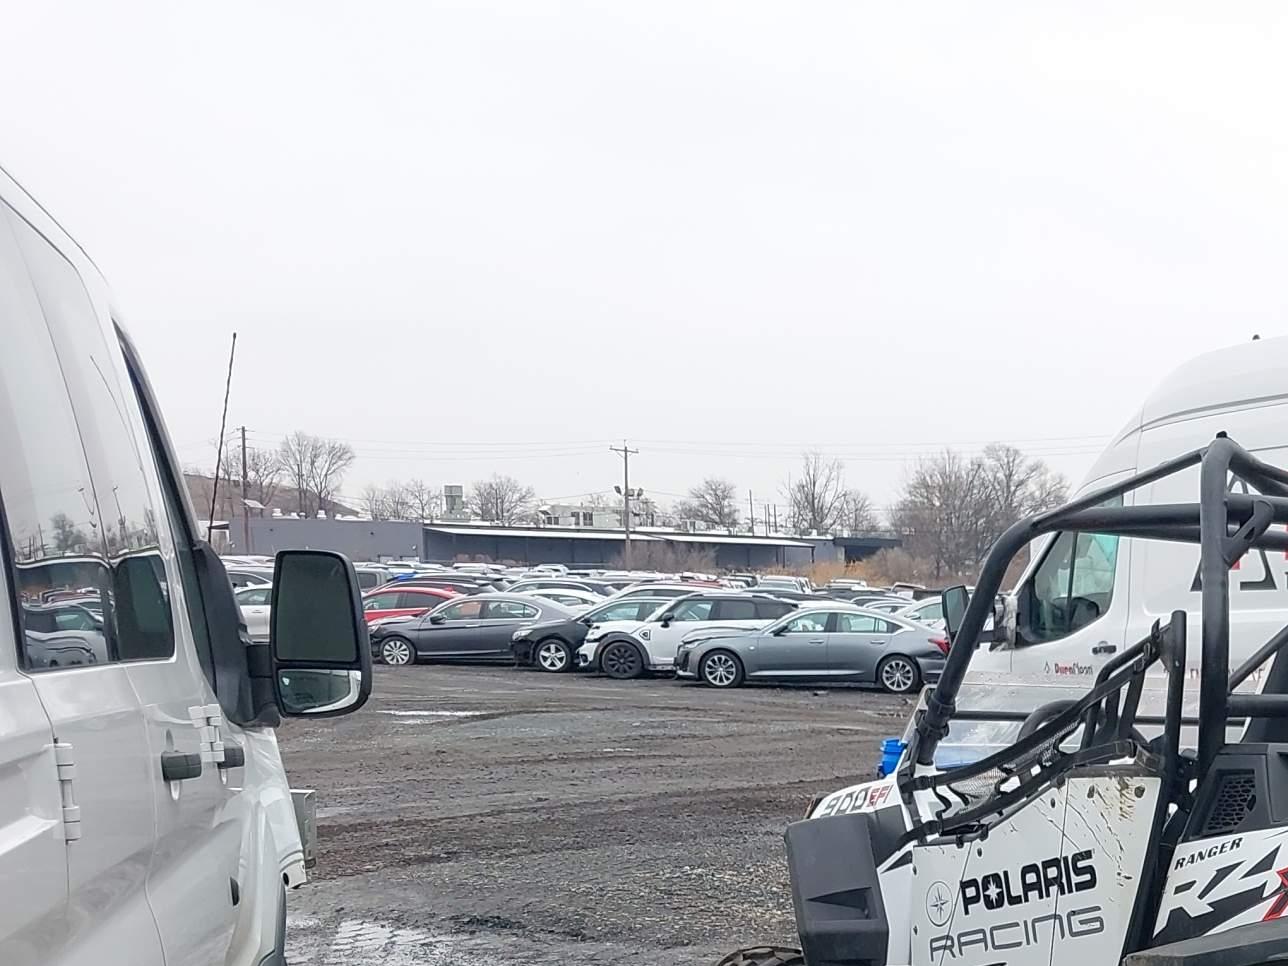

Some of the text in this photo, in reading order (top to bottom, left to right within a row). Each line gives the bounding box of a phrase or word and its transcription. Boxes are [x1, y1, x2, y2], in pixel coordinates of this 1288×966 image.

[1174, 837, 1243, 870] RANGER
[959, 850, 1097, 915] POLARIS
[930, 905, 1105, 962] RACING
